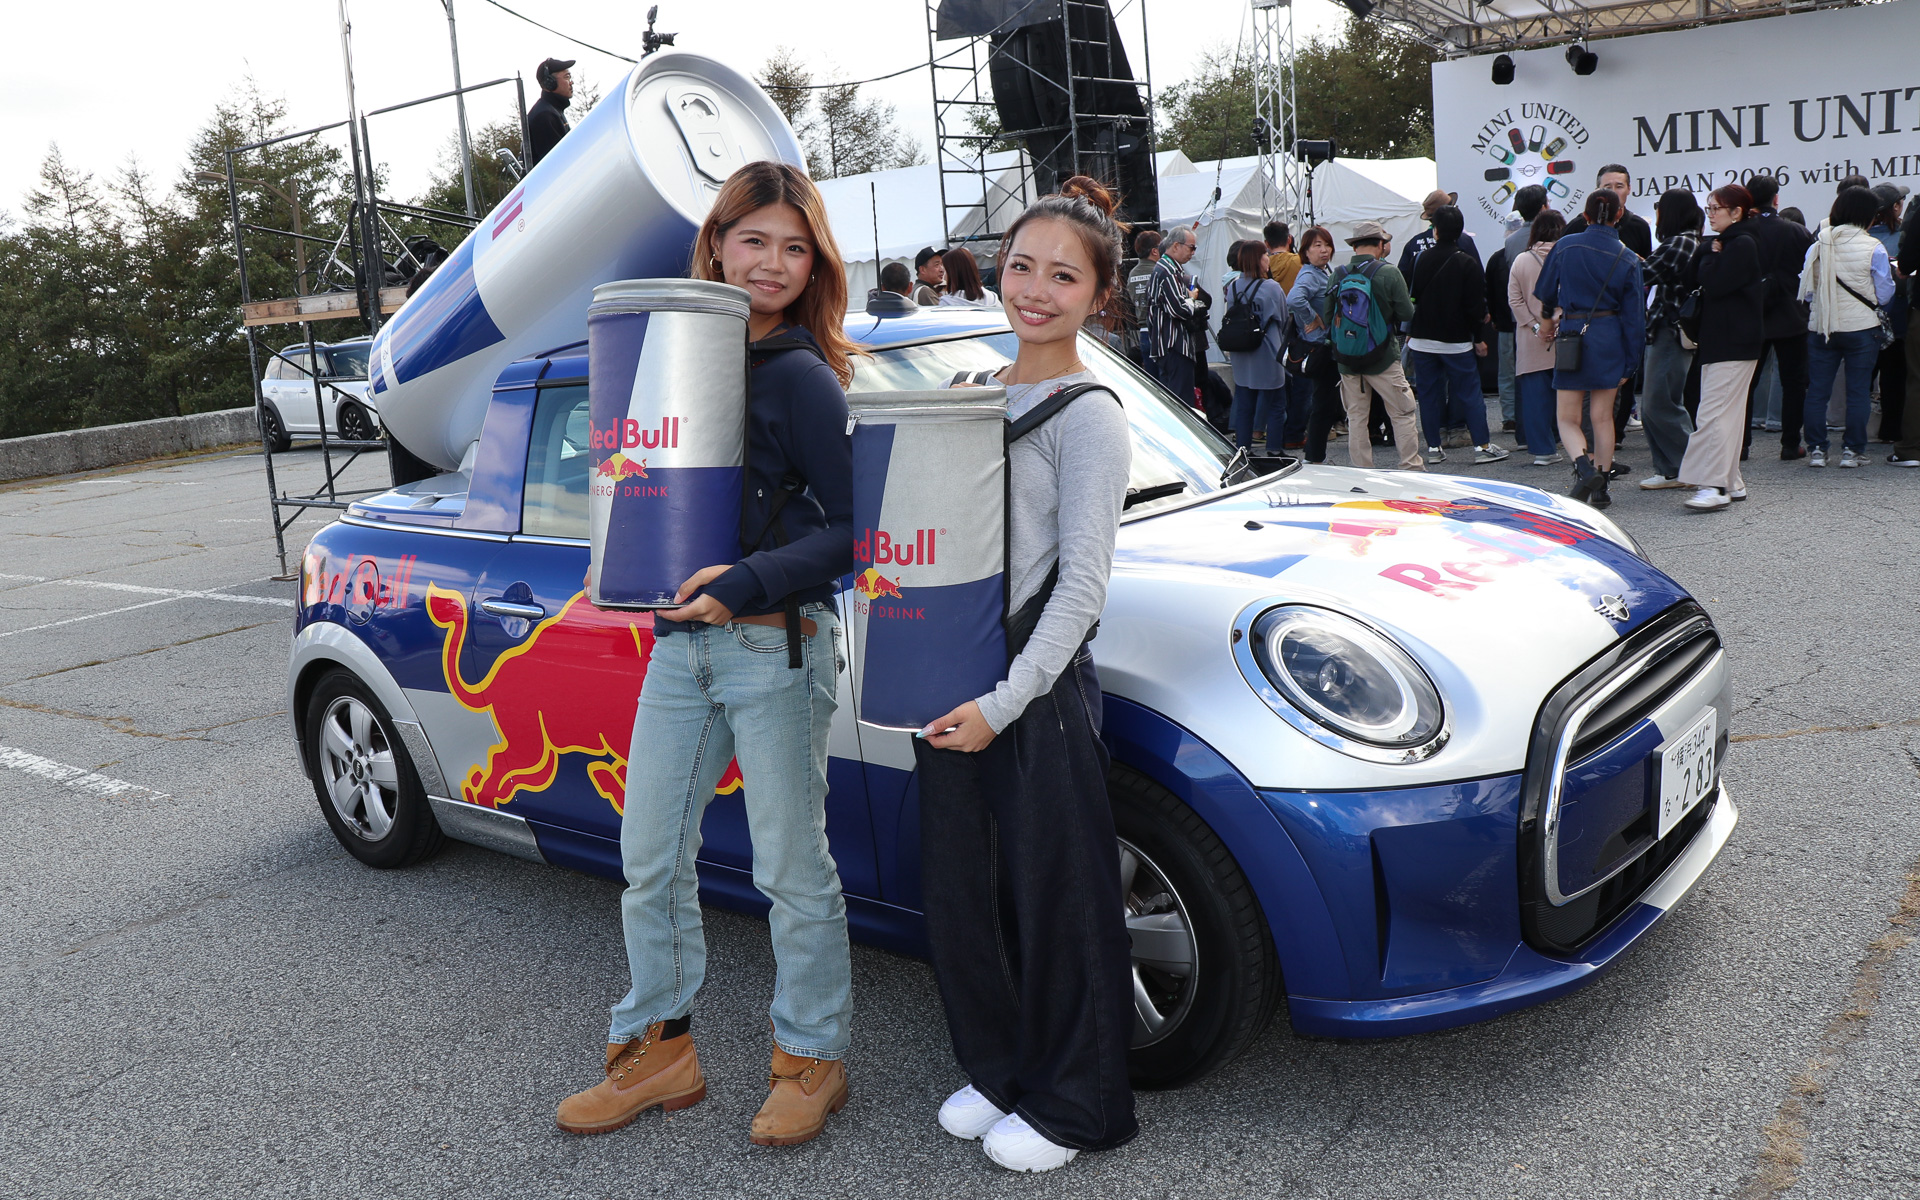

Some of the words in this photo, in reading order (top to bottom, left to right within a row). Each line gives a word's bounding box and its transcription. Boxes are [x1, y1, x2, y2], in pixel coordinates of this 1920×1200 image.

[1471, 107, 1515, 155] MINI
[1521, 102, 1590, 150] UNITED.
[1632, 103, 1770, 157] MINI
[1632, 171, 1715, 198] JAPAN
[1799, 159, 1860, 184] with
[1478, 196, 1500, 221] JAPAN
[1562, 188, 1585, 215] LIVE!
[622, 416, 679, 449] Bull
[624, 486, 669, 497] DRINK
[853, 528, 871, 563] ed
[874, 528, 936, 566] Bull
[352, 554, 418, 609] Bull
[854, 600, 875, 616] ERGY
[878, 606, 926, 620] DRINK
